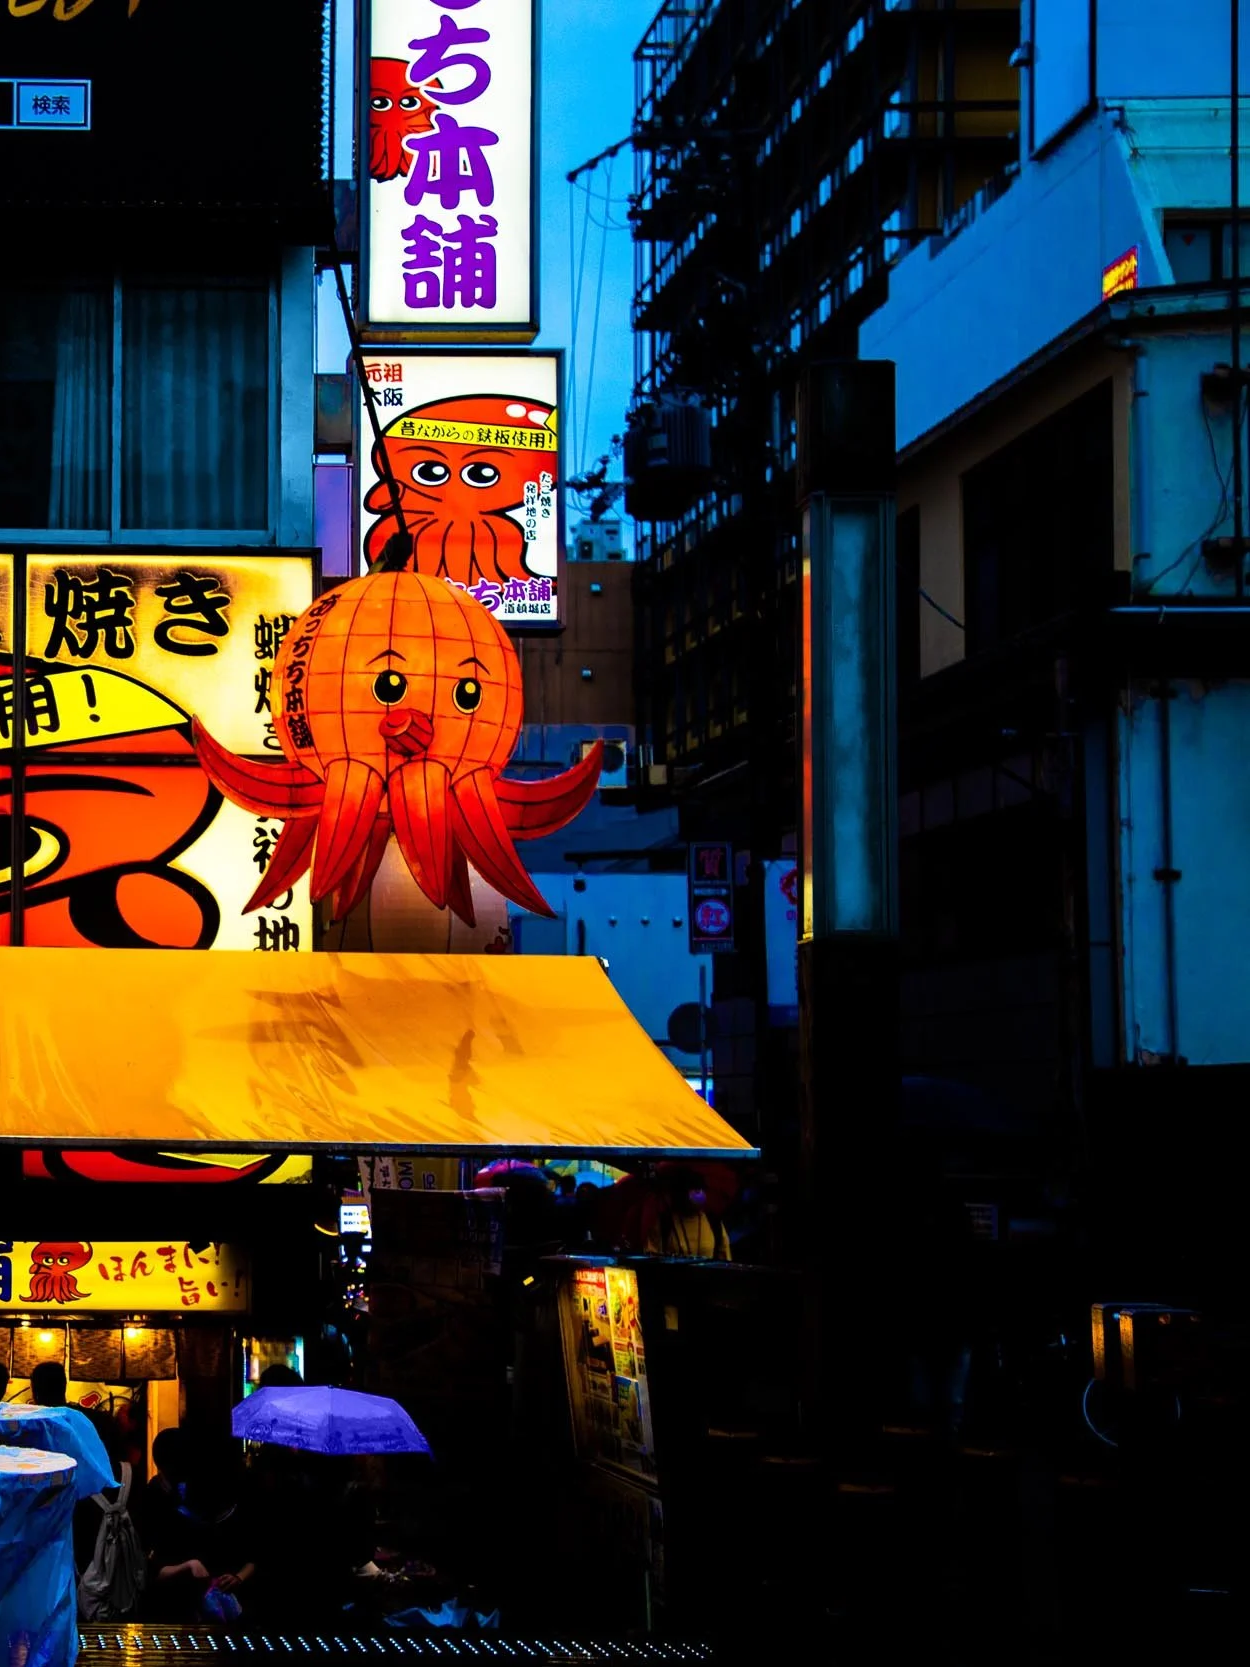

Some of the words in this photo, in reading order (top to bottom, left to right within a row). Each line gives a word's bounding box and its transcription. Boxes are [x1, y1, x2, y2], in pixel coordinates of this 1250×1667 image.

[31, 93, 71, 117] 検索
[401, 0, 499, 309] ち本舗
[364, 363, 403, 383] 元祖
[400, 421, 553, 449] 昔ながらの鉄板使用!
[447, 579, 551, 612] ち本舗
